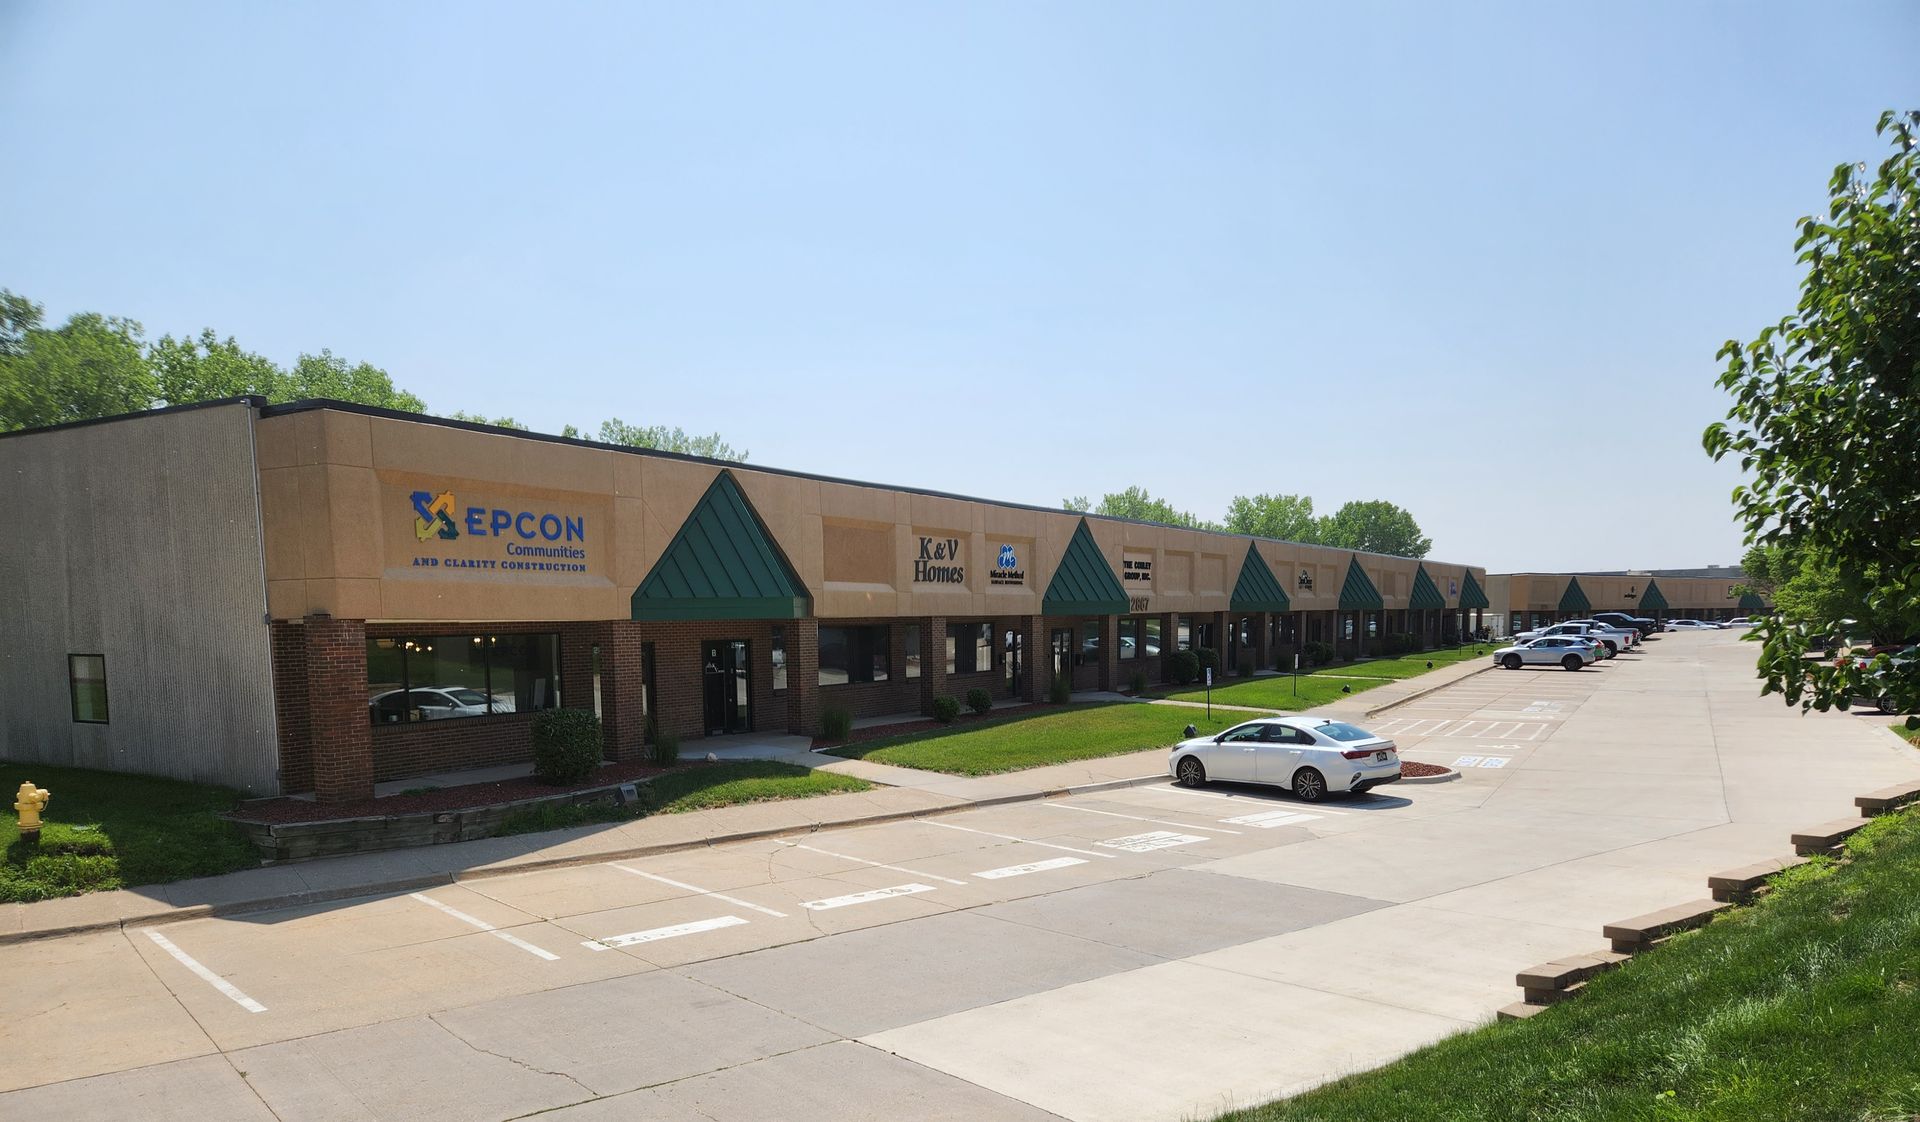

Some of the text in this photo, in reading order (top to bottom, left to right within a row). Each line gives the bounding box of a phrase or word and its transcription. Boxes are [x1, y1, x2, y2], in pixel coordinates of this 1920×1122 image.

[464, 507, 585, 542] EPCON
[506, 542, 585, 559] Communities
[918, 537, 959, 561] K & V
[412, 557, 587, 572] AND CLARITY CONSTRUCTION
[913, 559, 964, 584] Homes
[1123, 561, 1133, 569] THE
[1008, 570, 1025, 579] Method
